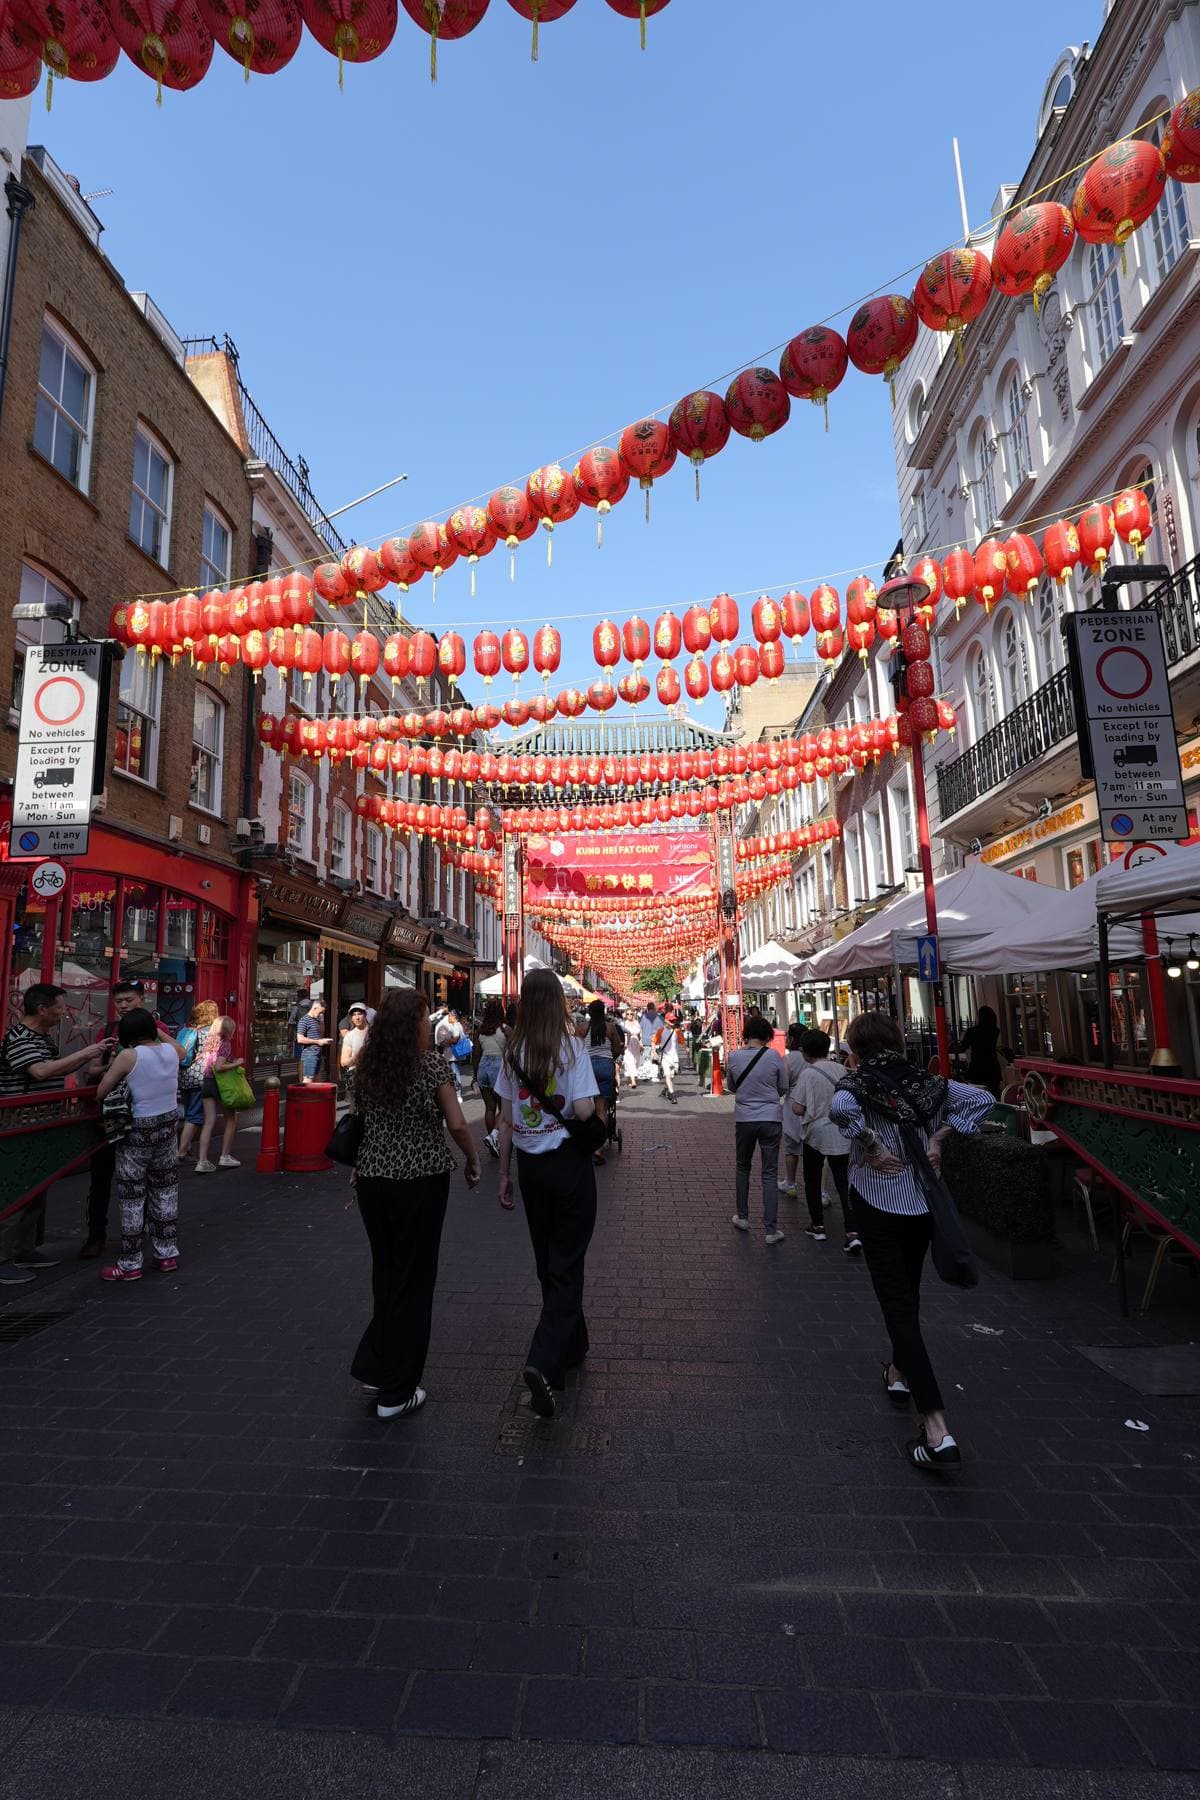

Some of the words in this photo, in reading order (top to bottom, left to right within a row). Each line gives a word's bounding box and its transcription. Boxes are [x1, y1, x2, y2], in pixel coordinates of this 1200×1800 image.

[1080, 615, 1153, 626] PEDESTRIAN
[1092, 628, 1146, 643] ZONE
[30, 648, 97, 658] PEDESTRIAN
[38, 660, 86, 673] ZONE
[1098, 704, 1113, 713] No
[1117, 703, 1160, 712] vehicles
[1103, 722, 1140, 731] Except
[1144, 721, 1159, 729] for
[29, 730, 42, 738] No
[46, 729, 85, 737] vehicles
[1105, 733, 1144, 742] loading
[1147, 732, 1160, 742] by
[31, 746, 64, 755] Except
[67, 745, 81, 753] for
[30, 757, 65, 766] loading
[69, 756, 80, 765] by
[1115, 770, 1161, 779] between
[1101, 782, 1125, 791] 7am
[1134, 782, 1144, 790] 11
[32, 791, 73, 799] between
[1114, 794, 1137, 802] Mon
[1146, 792, 1168, 801] Sun
[19, 802, 39, 811] 7am
[49, 801, 56, 809] 11
[27, 813, 50, 821] Mon
[56, 811, 75, 820] Sun
[1034, 803, 1084, 839] CORNER
[1142, 814, 1155, 822] At
[1158, 814, 1177, 823] any
[1150, 825, 1174, 834] time
[48, 831, 61, 839] At
[63, 831, 81, 840] any
[53, 841, 75, 850] time
[576, 847, 600, 856] KUNG
[602, 846, 617, 855] HEI
[618, 845, 635, 854] FAT
[636, 845, 660, 854] CHOY
[71, 893, 112, 914] SLOTS
